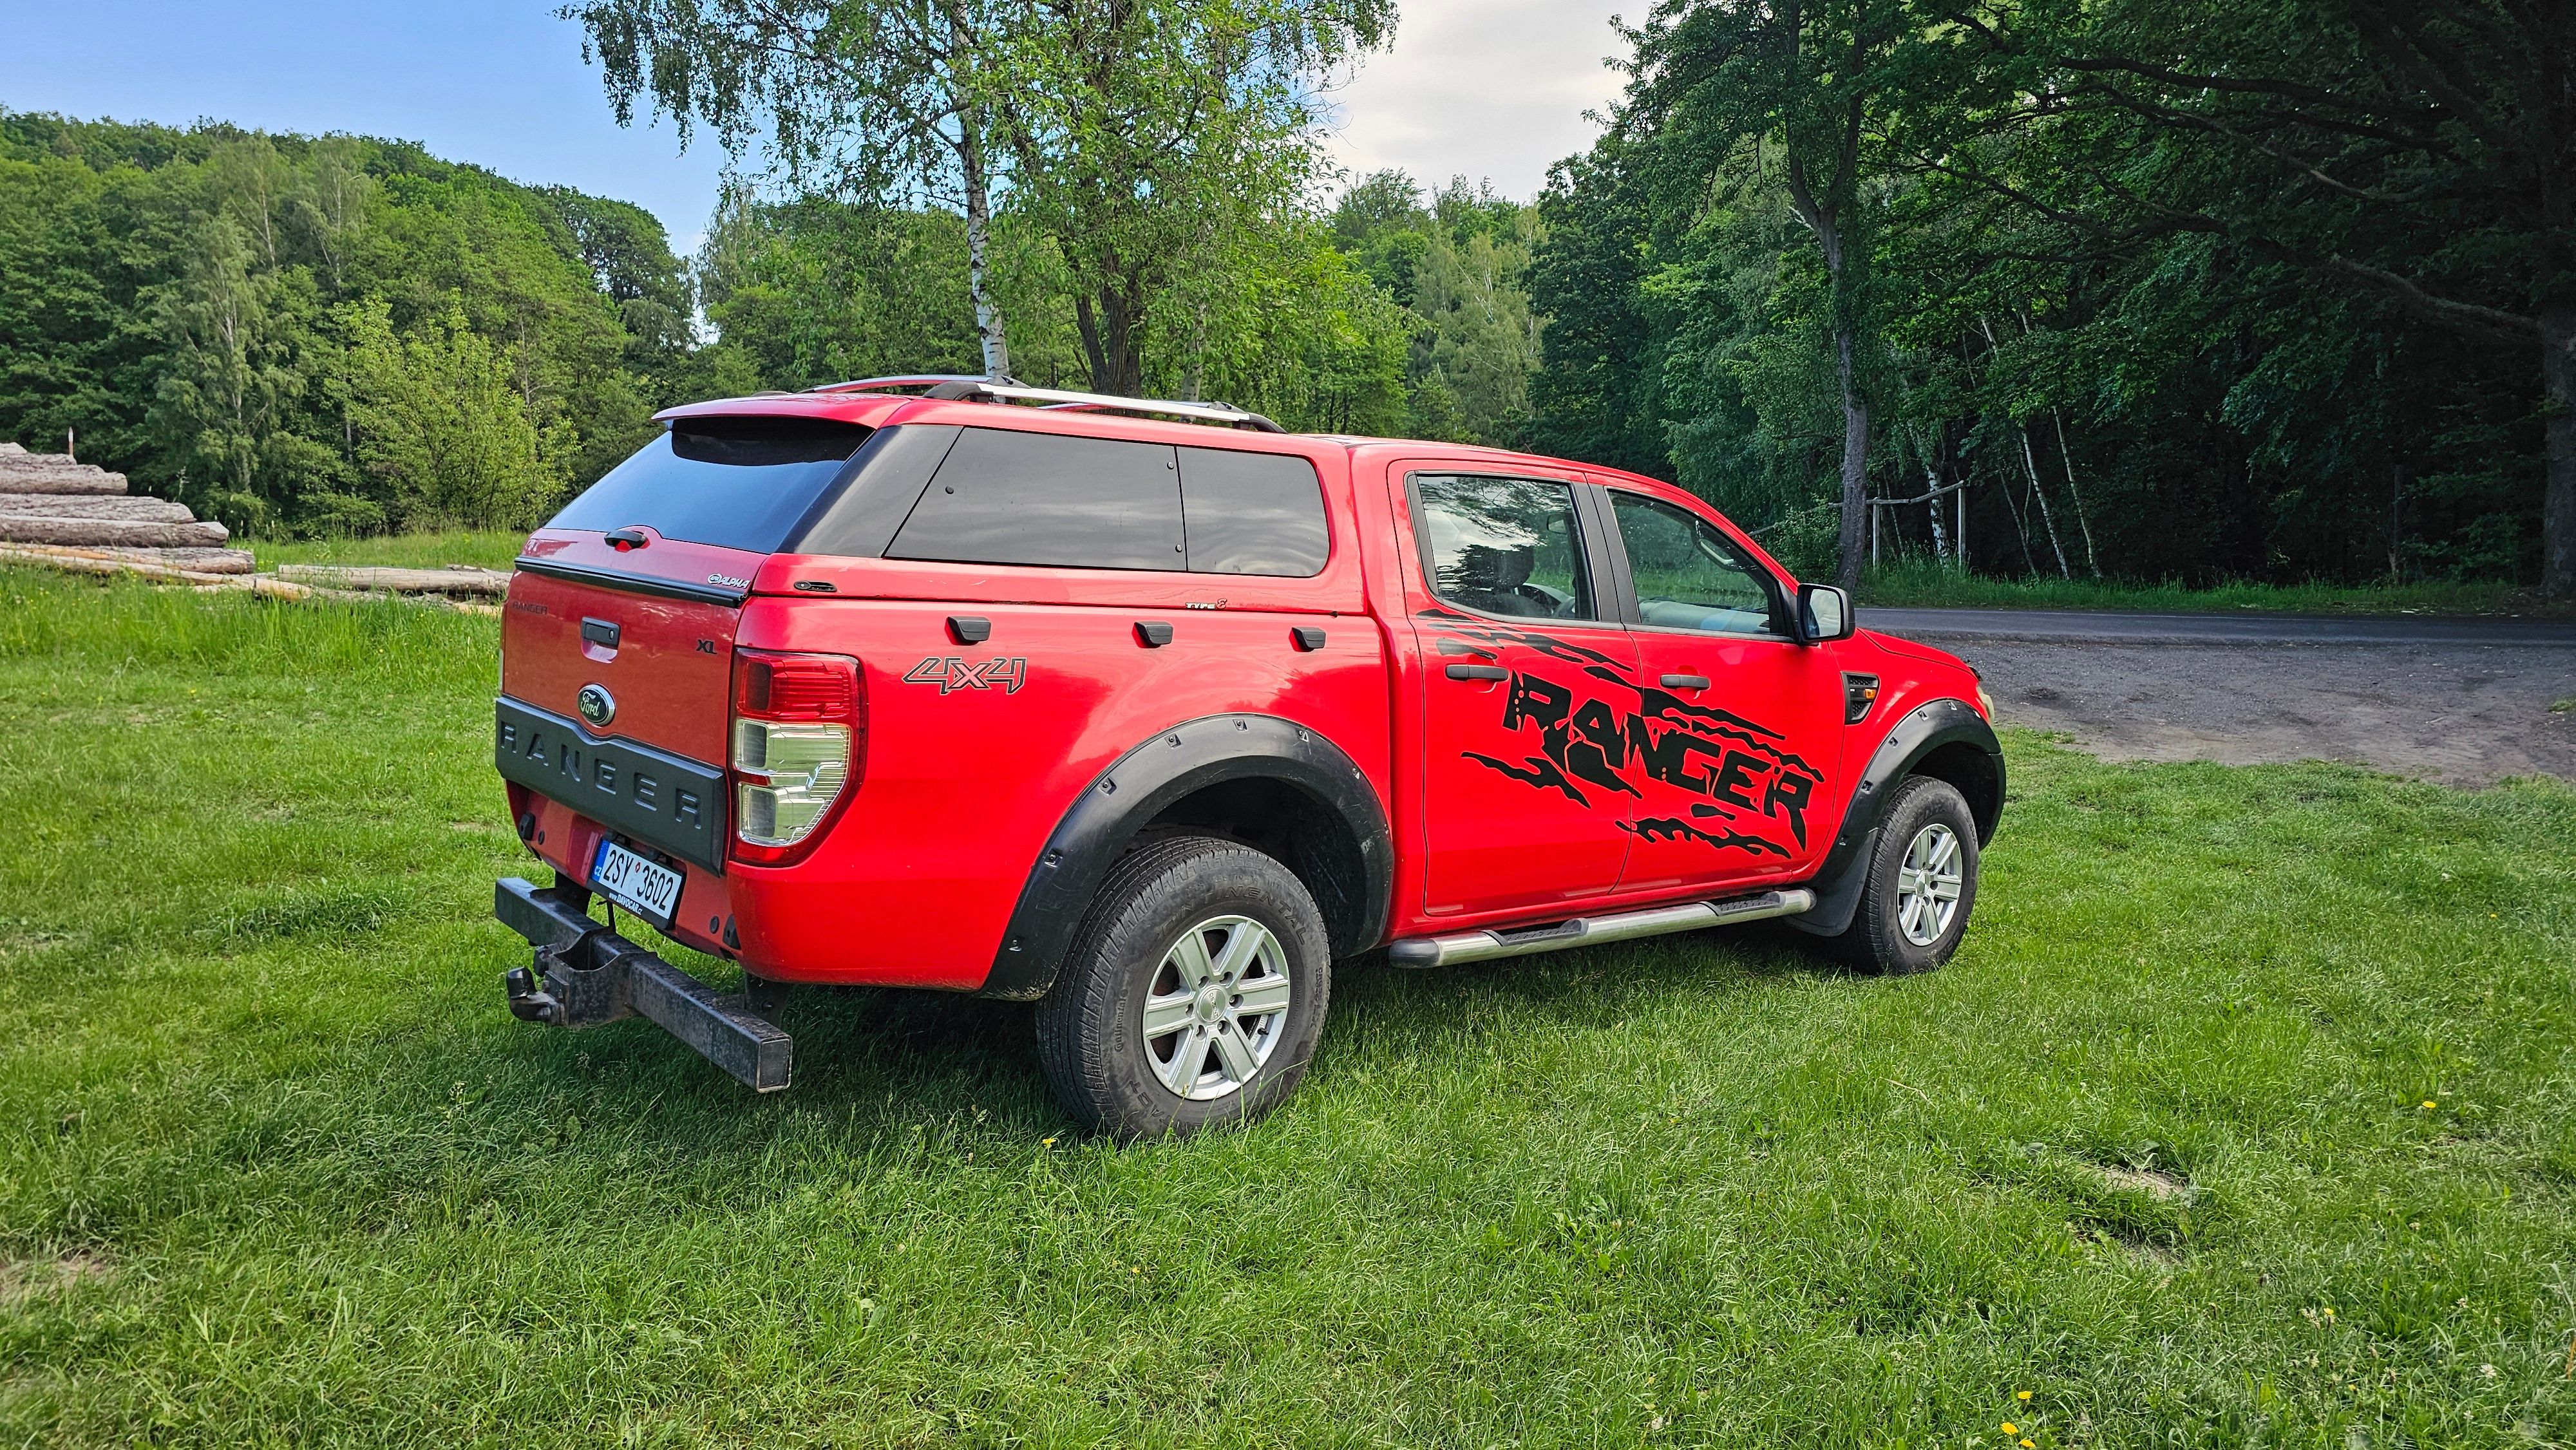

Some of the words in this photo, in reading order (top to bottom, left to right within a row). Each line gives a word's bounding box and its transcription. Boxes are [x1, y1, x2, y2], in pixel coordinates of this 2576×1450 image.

[717, 576, 750, 588] ALPHA
[513, 600, 547, 615] RANGER
[696, 639, 717, 654] XL
[580, 691, 600, 717] Ford
[1502, 670, 1814, 852] RANGER
[500, 720, 701, 830] RANGER
[593, 865, 602, 876] CZ
[603, 849, 634, 889] 2SY
[636, 865, 674, 911] 3602
